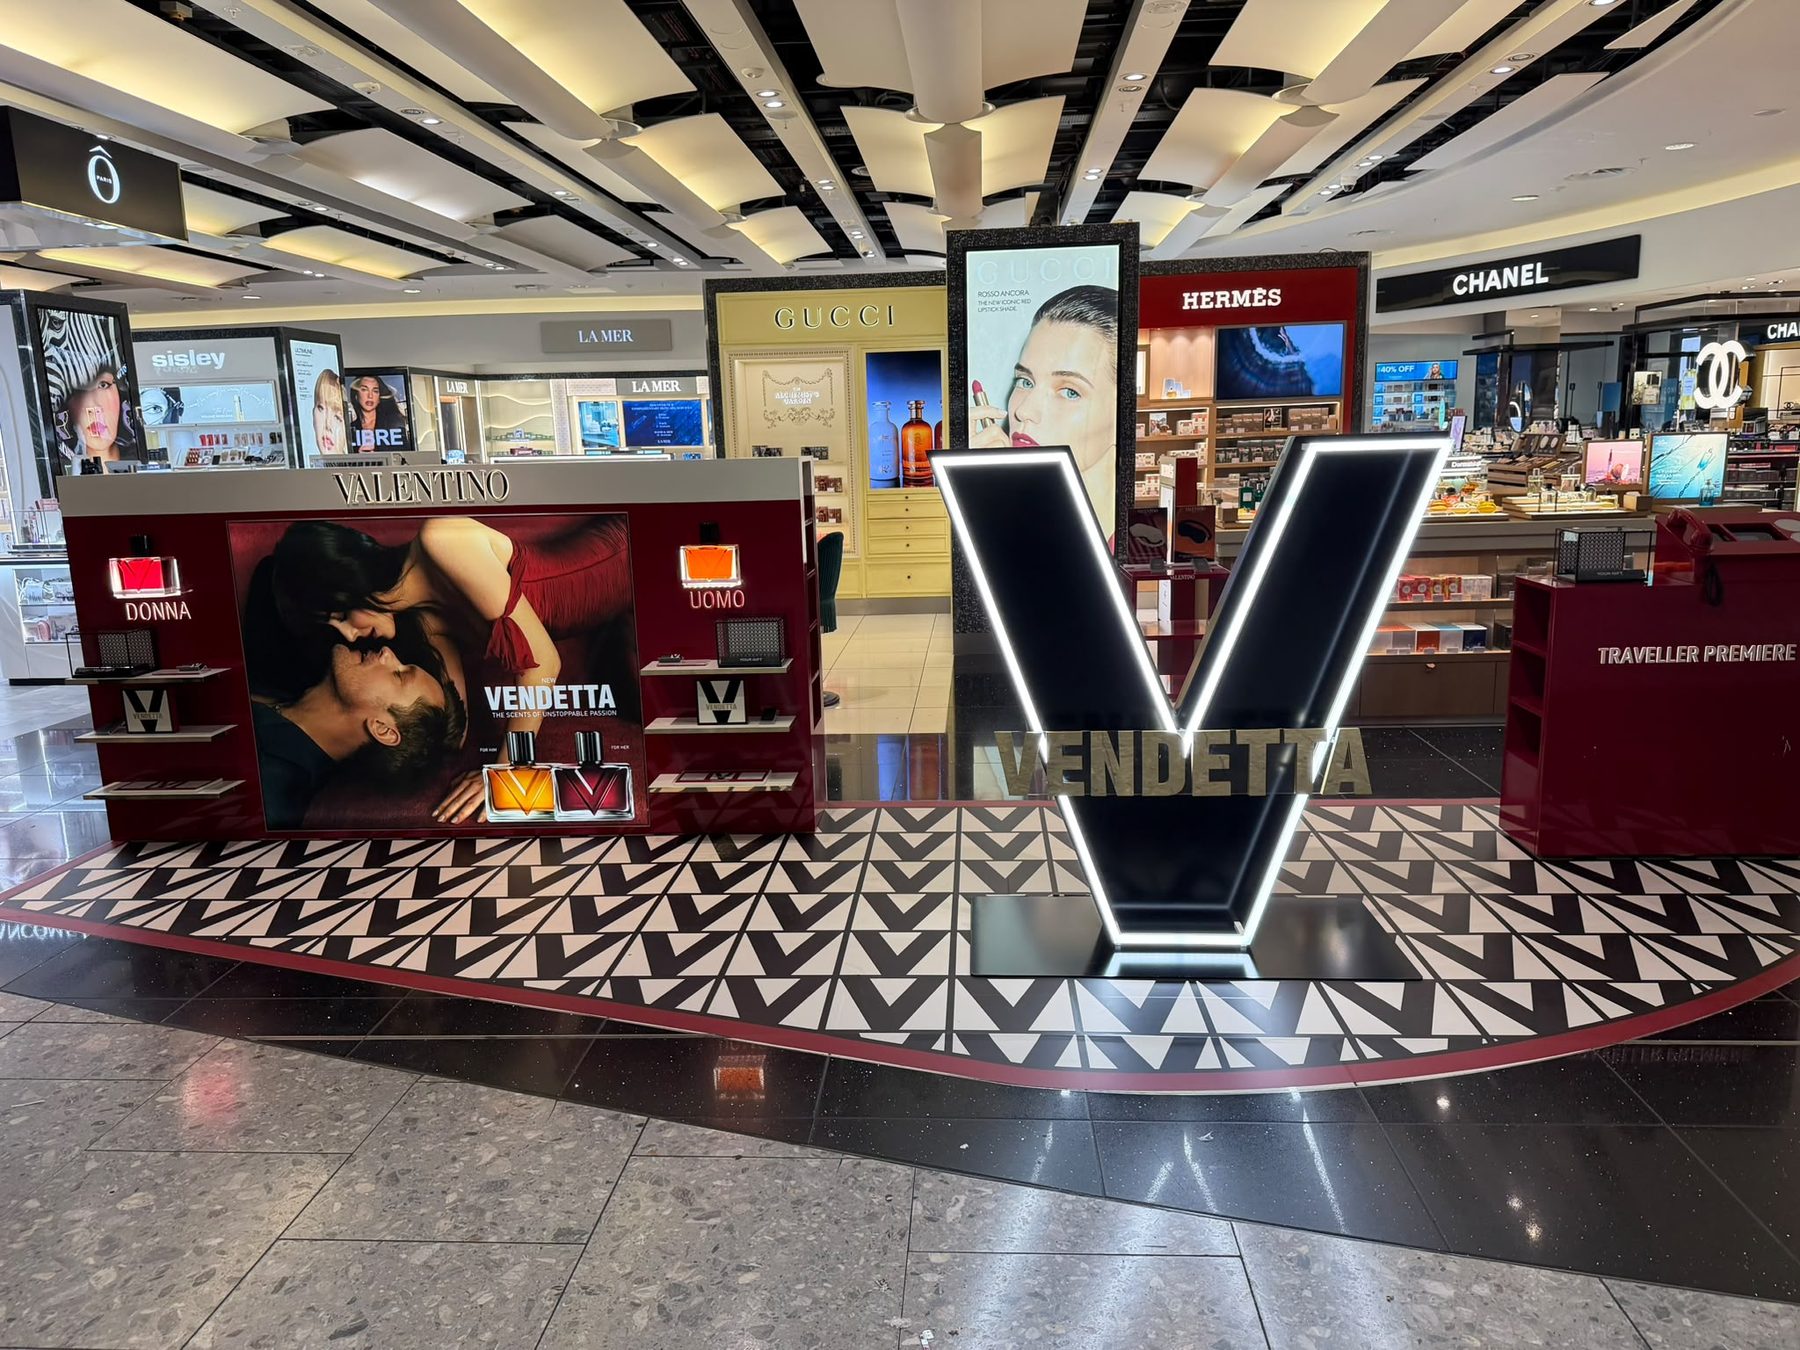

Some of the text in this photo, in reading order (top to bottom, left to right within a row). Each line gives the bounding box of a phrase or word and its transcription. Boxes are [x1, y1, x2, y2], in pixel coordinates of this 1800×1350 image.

[1453, 262, 1549, 295] CHANEL
[1182, 287, 1282, 310] HERMÈS
[774, 305, 894, 330] GUCCI
[578, 329, 634, 343] LA MER
[1767, 322, 1800, 339] CHA
[152, 349, 225, 370] sisley
[1398, 365, 1415, 373] OFF
[446, 381, 468, 394] LA MER
[632, 380, 681, 393] LA MER
[332, 468, 510, 505] VALENTINO
[690, 590, 746, 609] UOMO
[125, 601, 192, 621] DONNA
[1598, 643, 1797, 665] TRAVELLER PREMIERE
[484, 684, 617, 711] VENDETTA
[542, 710, 588, 718] UNSTOPPABLE
[589, 709, 617, 717] PASSION
[994, 727, 1373, 798] VENDETTA
